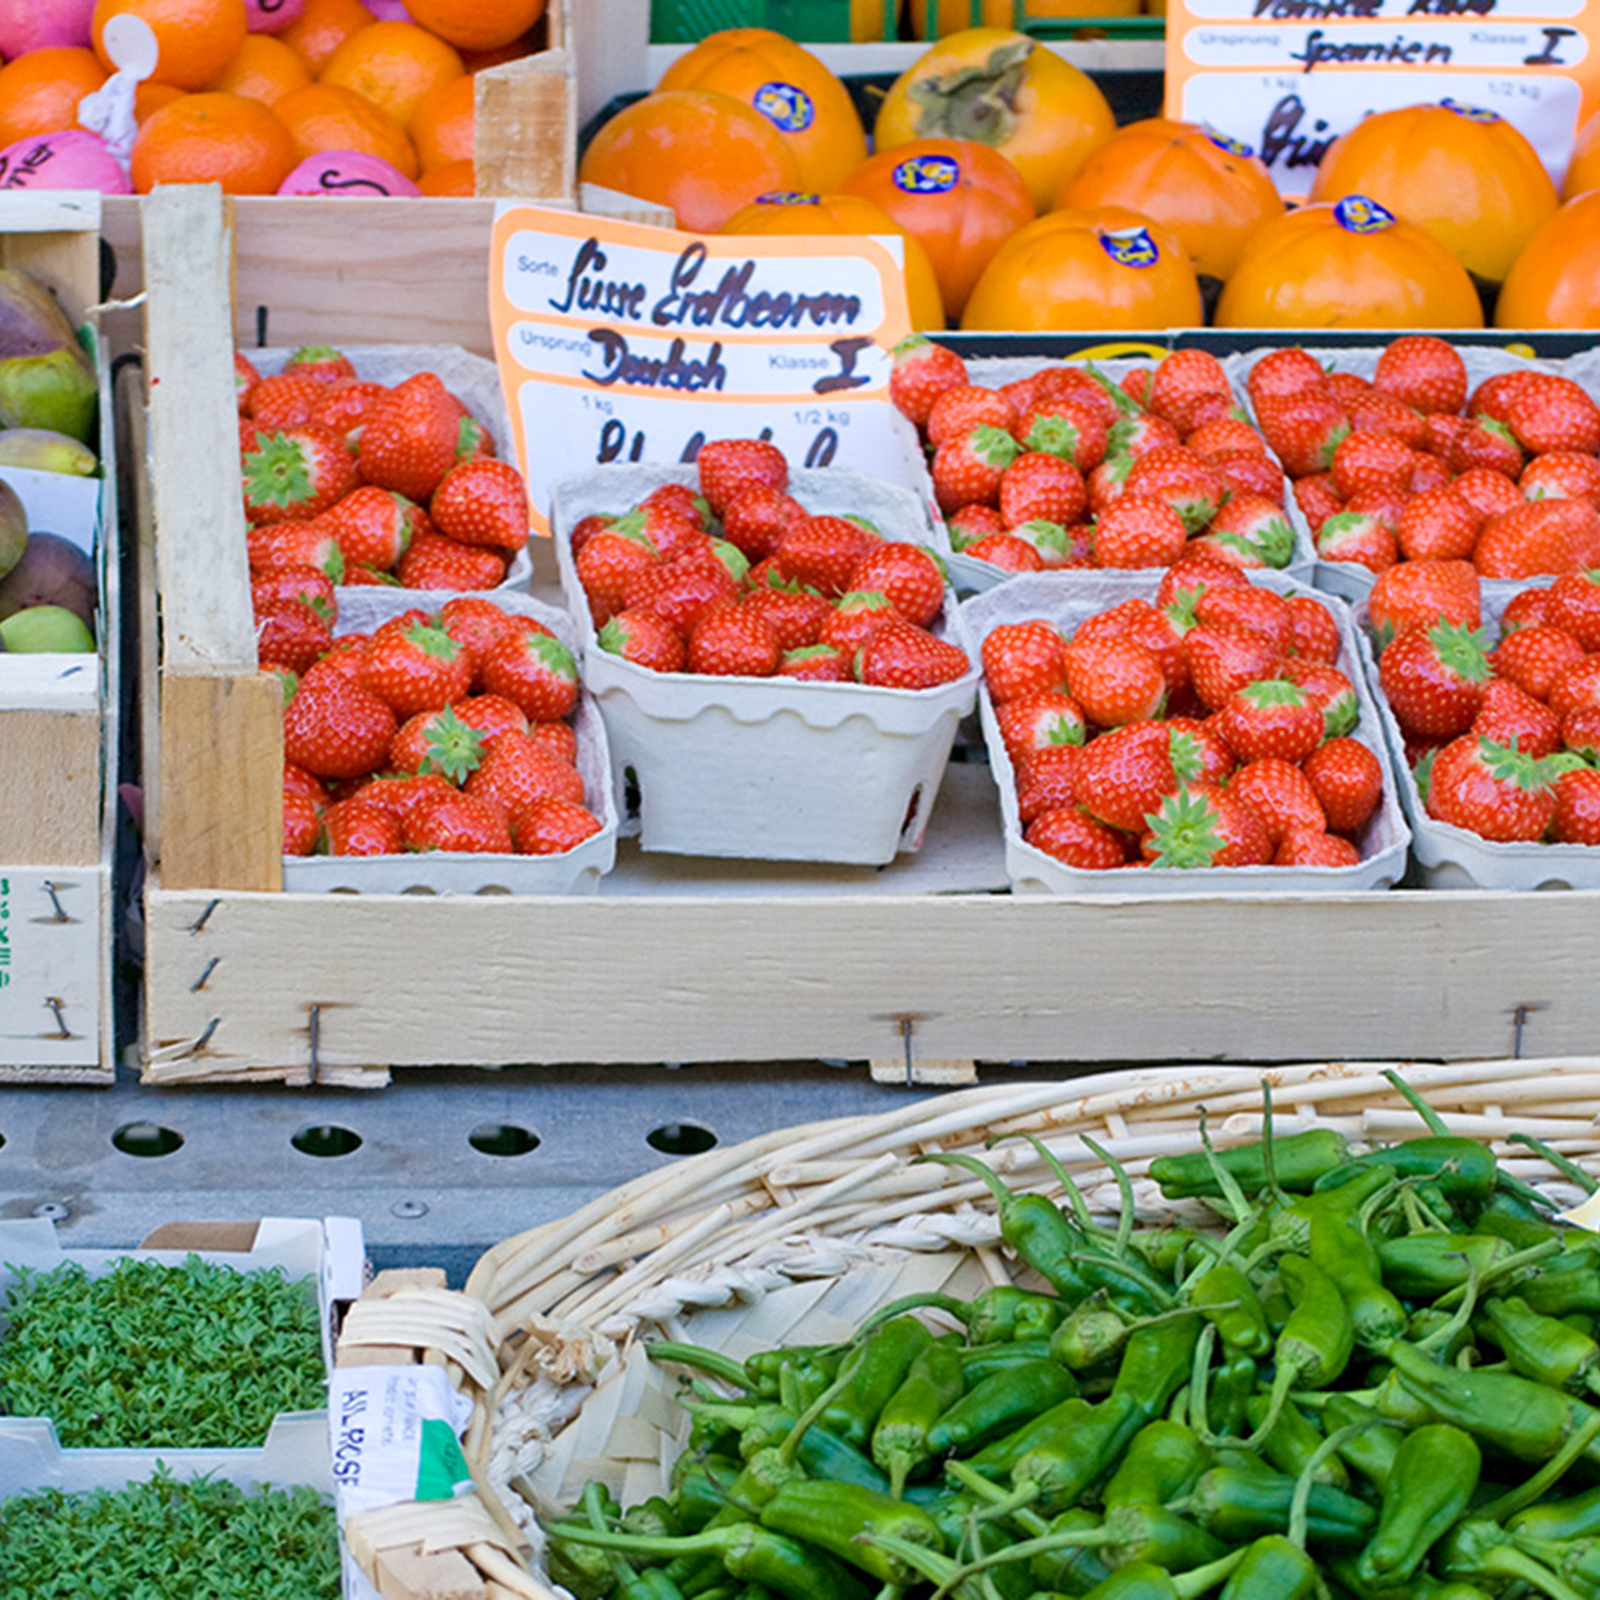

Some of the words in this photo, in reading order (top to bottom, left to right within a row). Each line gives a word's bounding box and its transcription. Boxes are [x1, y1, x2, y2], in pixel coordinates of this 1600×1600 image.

[1290, 29, 1453, 73] Spanien
[1523, 26, 1578, 66] I
[518, 255, 559, 277] Sorte
[651, 241, 862, 329] Erdbeeren
[519, 329, 593, 359] Ursprung
[768, 354, 830, 370] Klasse
[812, 337, 875, 394] I
[582, 394, 591, 408] 1
[594, 396, 614, 417] kg
[793, 409, 821, 425] 1/2
[826, 409, 851, 427] kg
